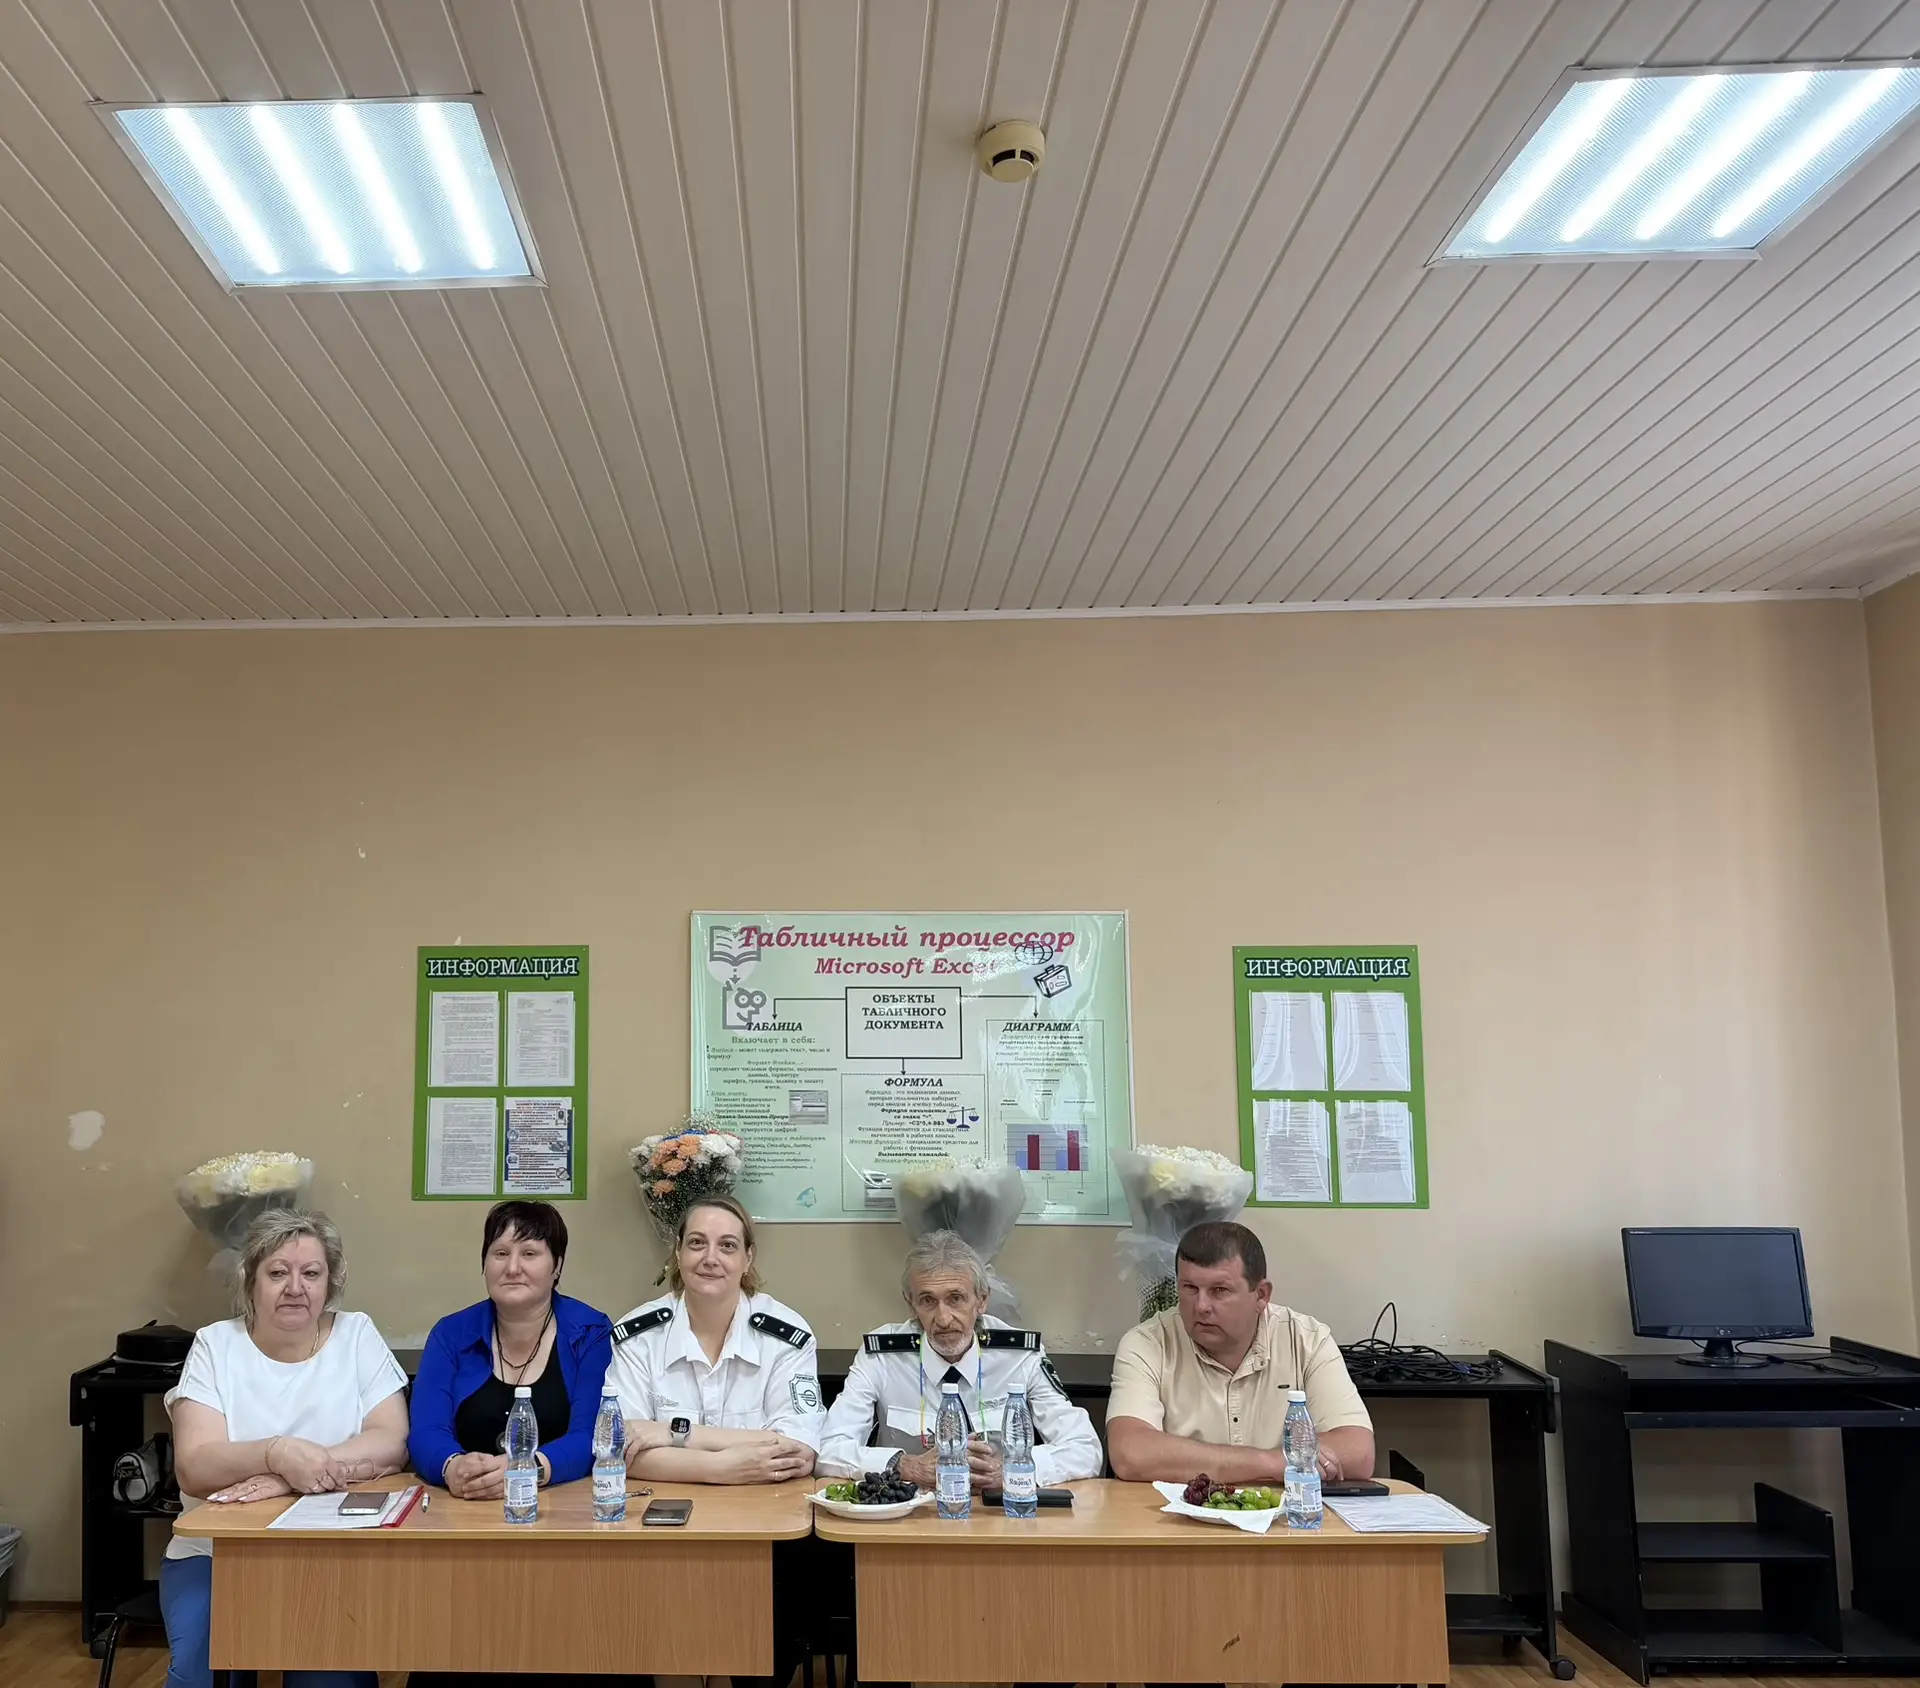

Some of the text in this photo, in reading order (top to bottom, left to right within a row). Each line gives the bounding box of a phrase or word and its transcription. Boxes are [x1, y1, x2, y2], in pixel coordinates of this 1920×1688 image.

[739, 925, 1075, 953] Табличный процессор
[427, 957, 579, 979] ИНФОРМАЦИЯ
[814, 957, 924, 979] Microsoft
[1245, 958, 1410, 980] ИНФОРМАЦИЯ
[872, 994, 936, 1004] ОБЪЕКТЫ
[861, 1007, 947, 1017] ТАБЛИЧНОГО
[746, 1022, 803, 1032] ТАБЛИЦА
[864, 1020, 945, 1031] ДОКУМЕНТА
[1002, 1022, 1081, 1032] ДИАГРАММА
[732, 1036, 778, 1044] Включает
[790, 1036, 816, 1044] себя:
[884, 1077, 944, 1087] ФОРМУЛА
